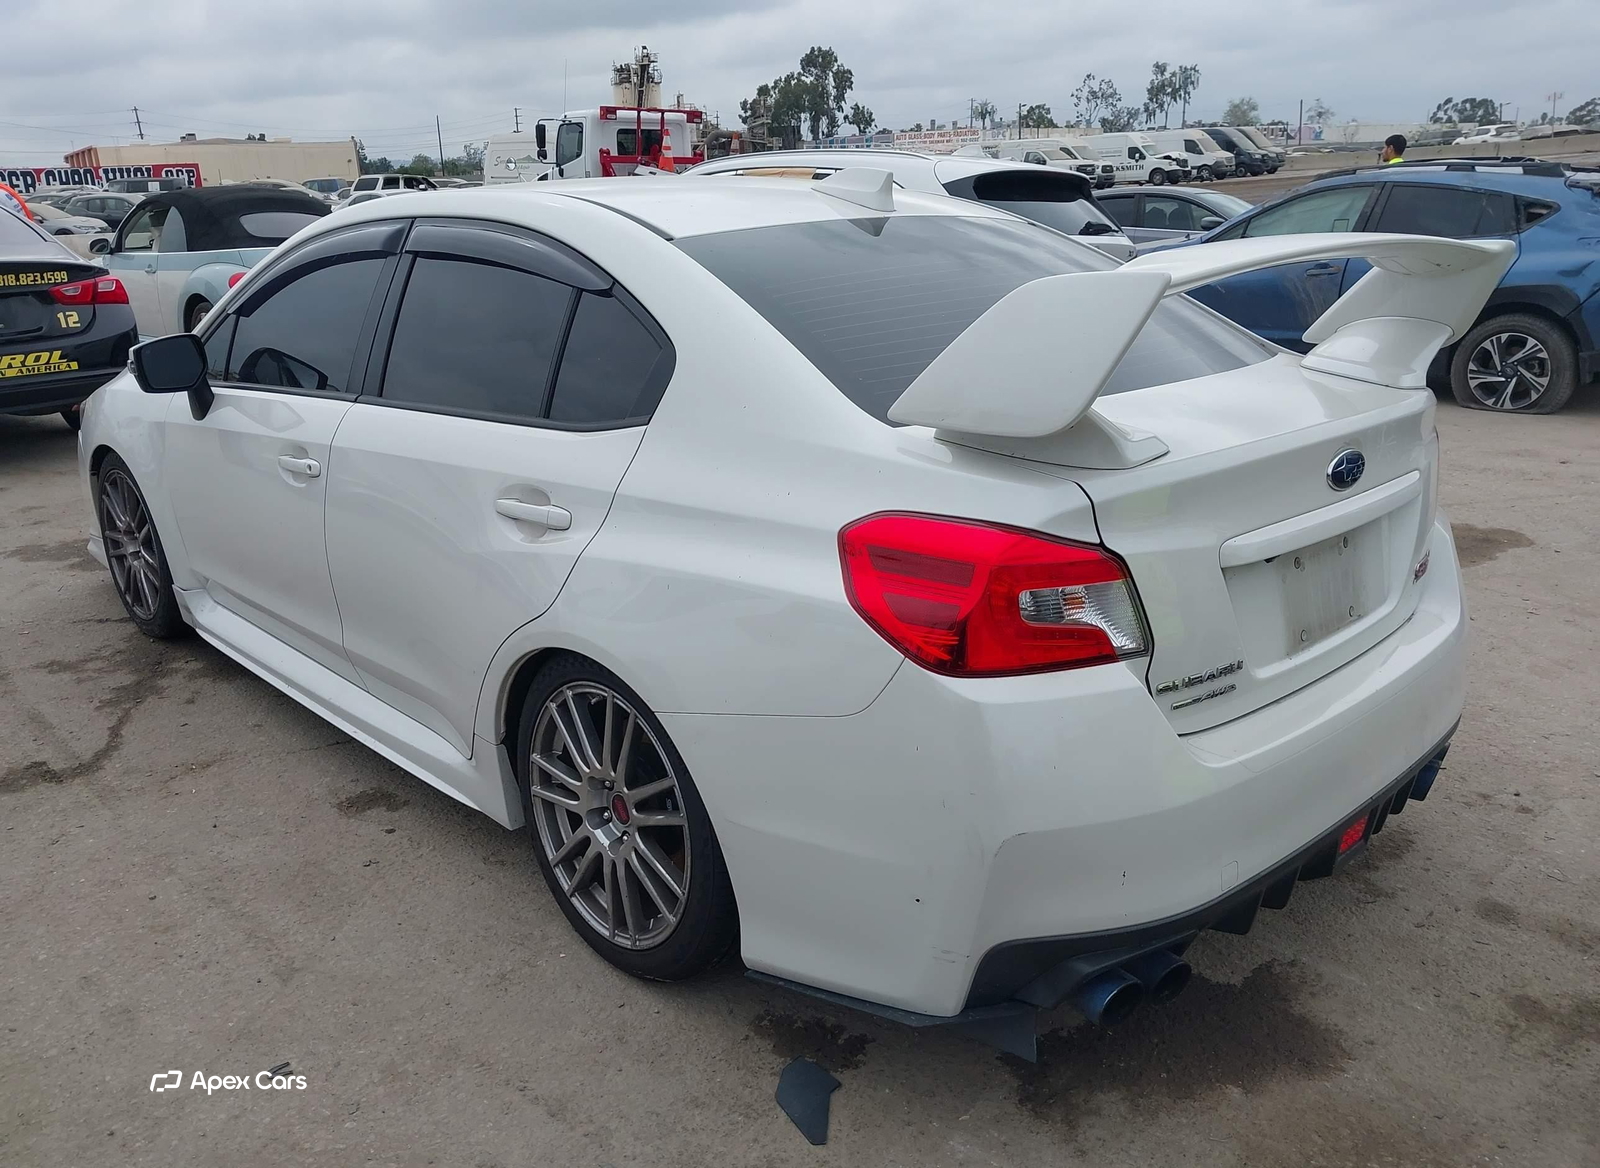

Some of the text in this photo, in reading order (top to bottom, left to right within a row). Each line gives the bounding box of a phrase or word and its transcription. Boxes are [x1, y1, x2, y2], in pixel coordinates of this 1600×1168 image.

[1113, 164, 1144, 172] KSMITH
[57, 311, 80, 328] 12
[0, 350, 68, 369] ROL
[16, 363, 72, 376] AMERICA
[1156, 659, 1244, 695] SUBARU
